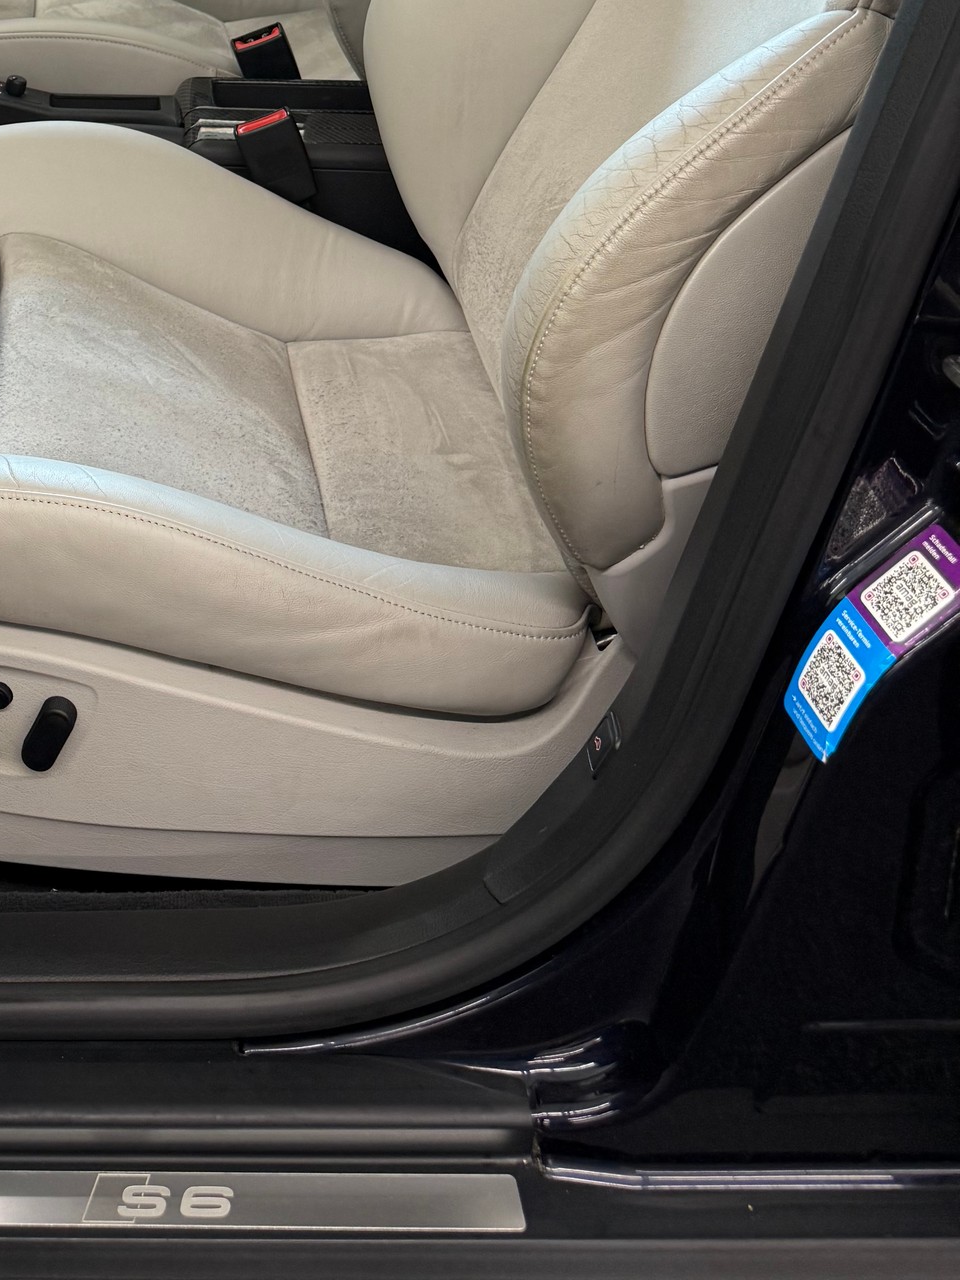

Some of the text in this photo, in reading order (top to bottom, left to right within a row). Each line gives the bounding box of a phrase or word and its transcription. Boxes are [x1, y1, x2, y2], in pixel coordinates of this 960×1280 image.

[921, 540, 940, 560] melden
[929, 534, 958, 564] Schadenfall
[895, 582, 918, 609] amag
[836, 617, 860, 648] vereinbaren
[841, 609, 871, 649] Service-Termin
[117, 1184, 234, 1218] S6
